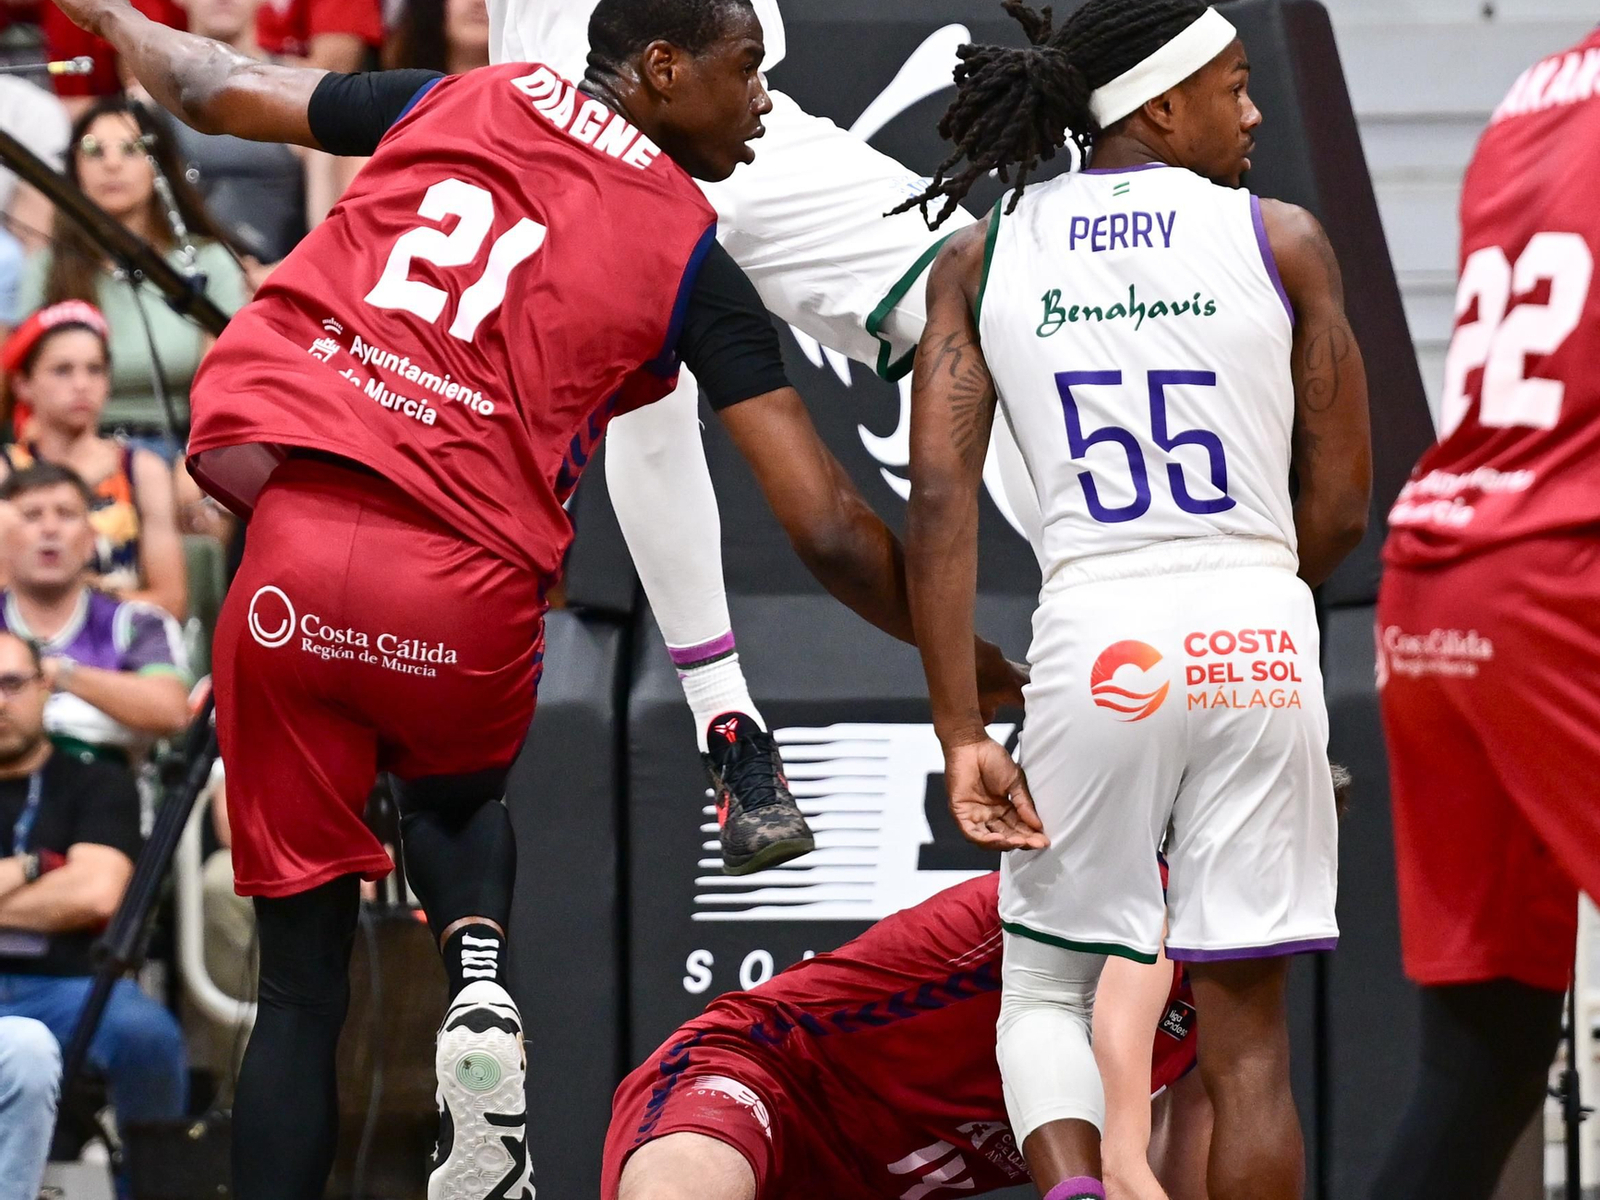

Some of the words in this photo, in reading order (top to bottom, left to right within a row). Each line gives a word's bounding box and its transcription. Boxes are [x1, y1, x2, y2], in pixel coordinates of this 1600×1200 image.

[510, 66, 662, 171] DIAGNE
[1069, 210, 1177, 253] PERRY
[363, 177, 547, 344] 21
[1438, 231, 1595, 448] 22
[349, 334, 496, 417] Ayuntamiento
[363, 377, 438, 426] Murcia
[1054, 369, 1237, 524] 55
[300, 613, 369, 648] Costa
[376, 633, 459, 665] Cálida
[301, 637, 355, 660] Región
[358, 649, 378, 664] de
[381, 655, 437, 678] Murcia
[1183, 628, 1299, 658] COSTA
[1185, 661, 1245, 686] DEL
[1251, 660, 1303, 684] SOL
[1186, 684, 1303, 712] MÁLAGA
[1169, 1009, 1184, 1023] liga
